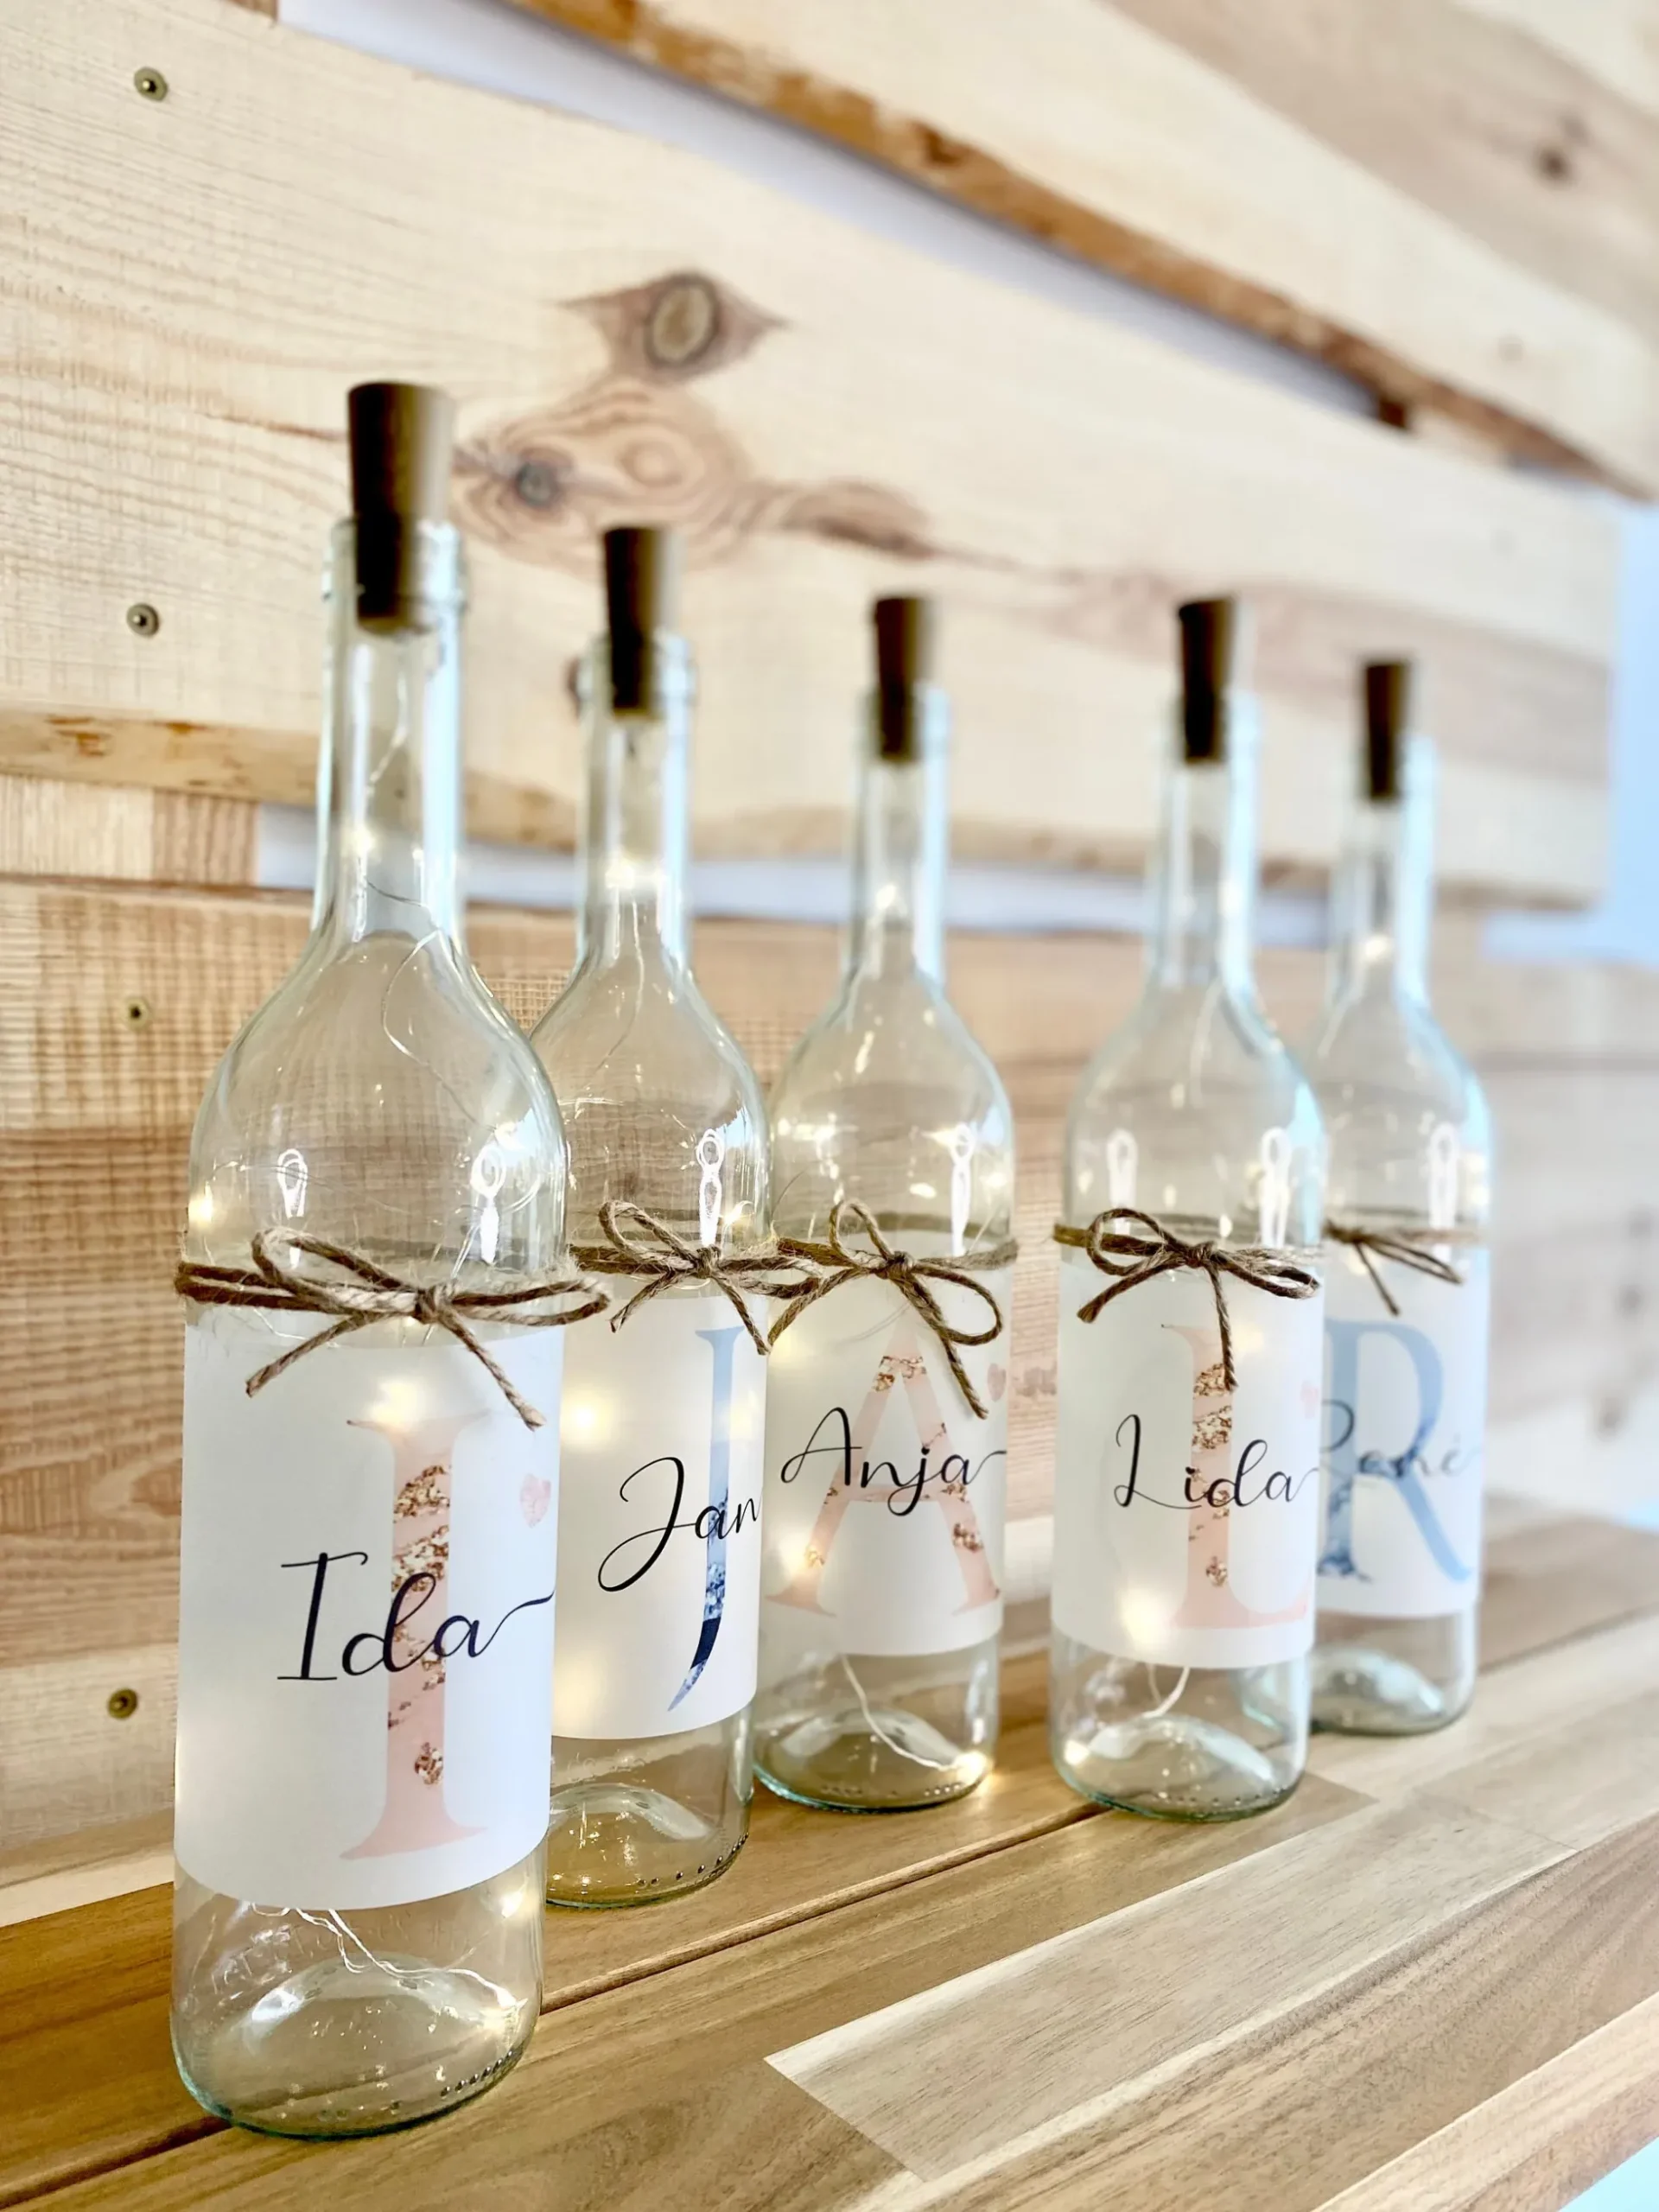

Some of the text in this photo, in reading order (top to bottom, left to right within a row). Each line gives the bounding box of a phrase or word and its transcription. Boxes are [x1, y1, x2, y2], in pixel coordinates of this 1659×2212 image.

[597, 1457, 762, 1592] Jan
[668, 1325, 746, 1712] J
[765, 1310, 1002, 1618] A
[779, 1406, 1007, 1516] Anja
[1113, 1414, 1320, 1510] Lida
[1161, 1323, 1308, 1630] L
[1316, 1319, 1472, 1584] R
[276, 1551, 556, 1681] Ida
[339, 1408, 492, 1859] I
